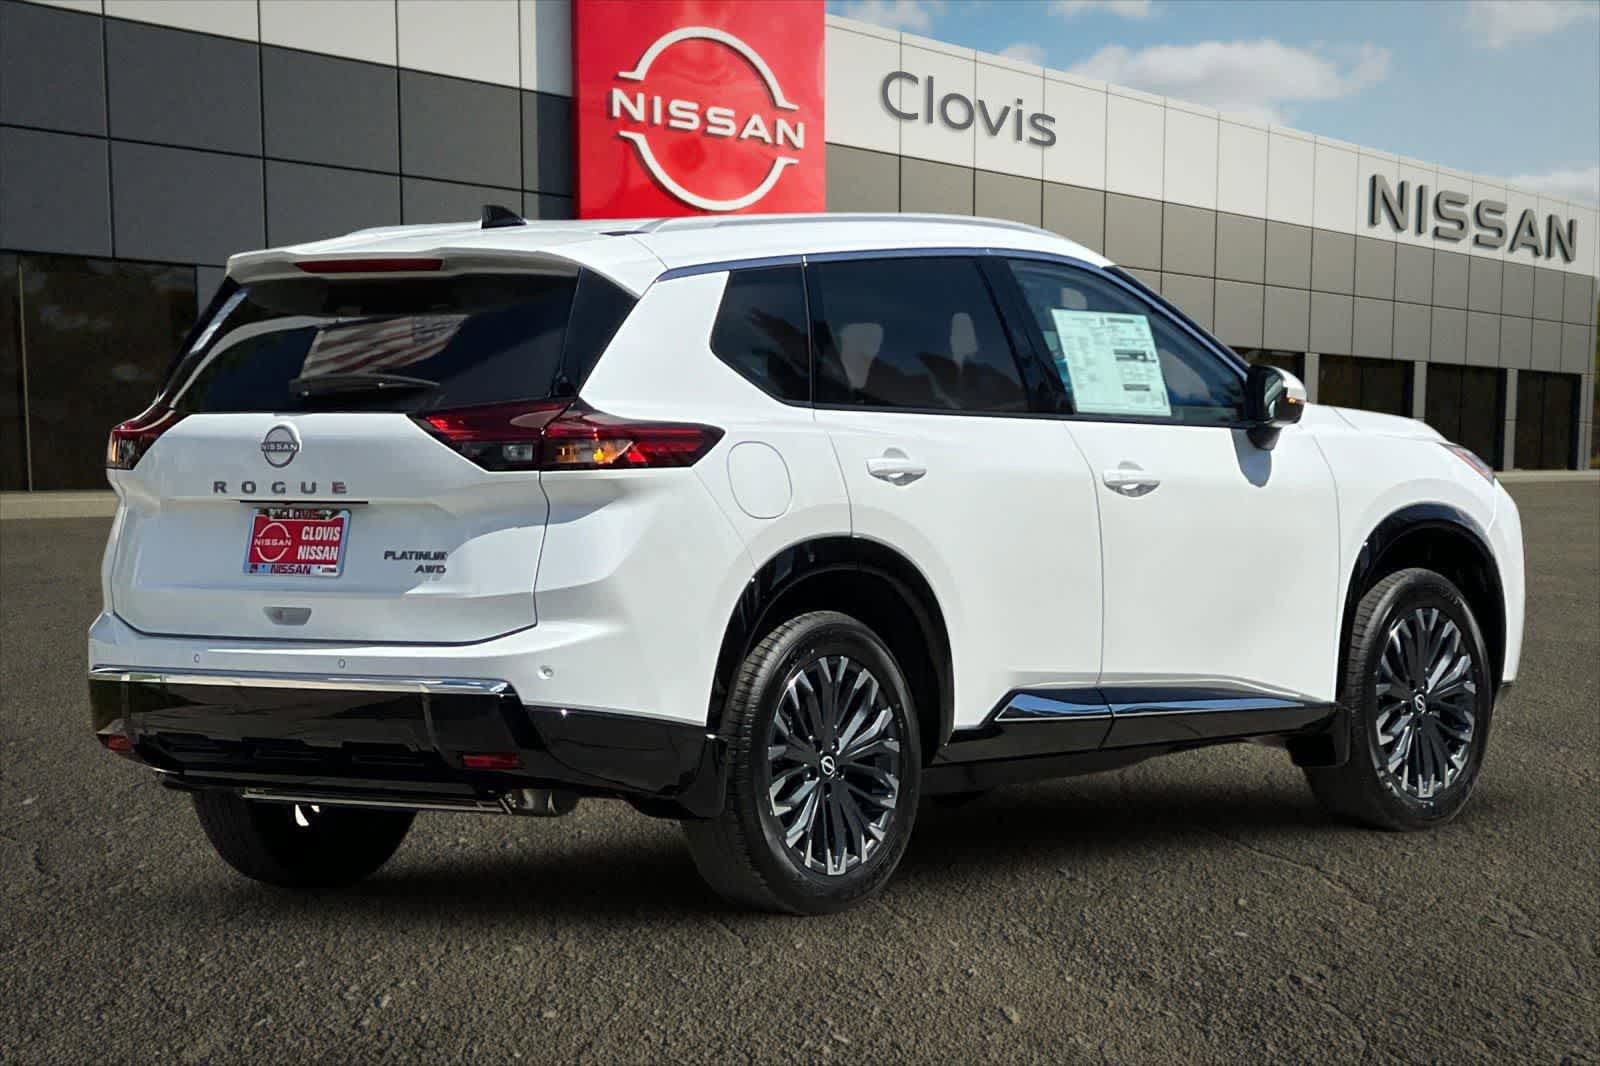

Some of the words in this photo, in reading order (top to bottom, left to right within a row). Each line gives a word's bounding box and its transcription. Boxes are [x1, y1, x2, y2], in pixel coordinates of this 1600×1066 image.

[881, 70, 1057, 147] Clovis
[610, 86, 806, 149] NISSAN
[1368, 173, 1578, 264] NISSAN
[262, 442, 298, 452] NISSAN
[213, 480, 348, 495] ROGUE
[302, 526, 341, 542] CLOVIS
[255, 537, 293, 547] NISSAN
[297, 544, 339, 561] NISSAN
[271, 564, 312, 575] NISSAN
[414, 564, 447, 575] AWD
